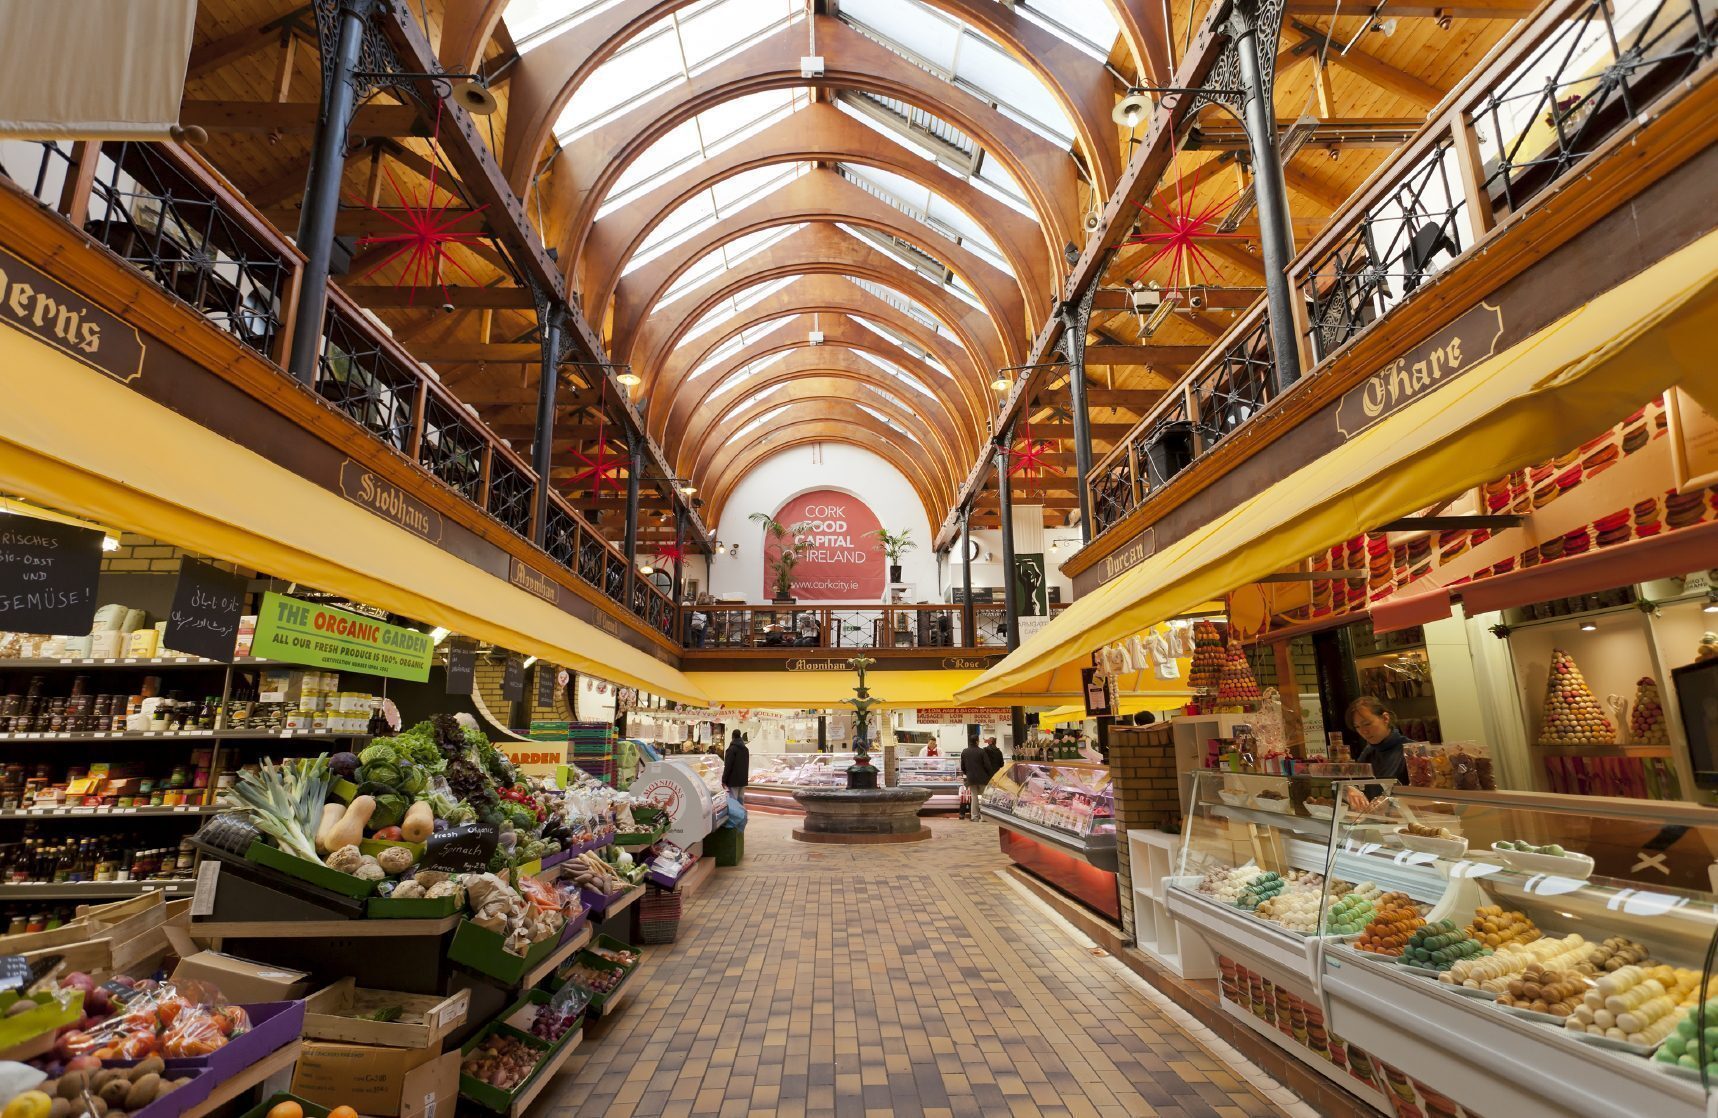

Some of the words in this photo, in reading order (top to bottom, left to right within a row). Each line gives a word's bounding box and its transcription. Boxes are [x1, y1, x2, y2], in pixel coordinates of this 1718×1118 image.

[805, 505, 846, 518] CORK
[795, 535, 855, 548] CAPITAL
[806, 550, 866, 563] IRELAND
[23, 571, 47, 581] UND
[278, 602, 310, 626] THE
[313, 611, 380, 643] ORGANIC
[382, 628, 428, 654] GARDEN
[272, 633, 289, 645] ALL
[292, 637, 311, 649] OUR
[314, 641, 338, 655] FRESH
[340, 645, 372, 660] PRODUCE
[372, 653, 380, 662] IS
[381, 654, 398, 664] 100%
[399, 658, 424, 670] ORGANIC
[951, 656, 979, 668] Rose
[506, 752, 561, 765] ARDEN
[439, 842, 482, 857] Spinach
